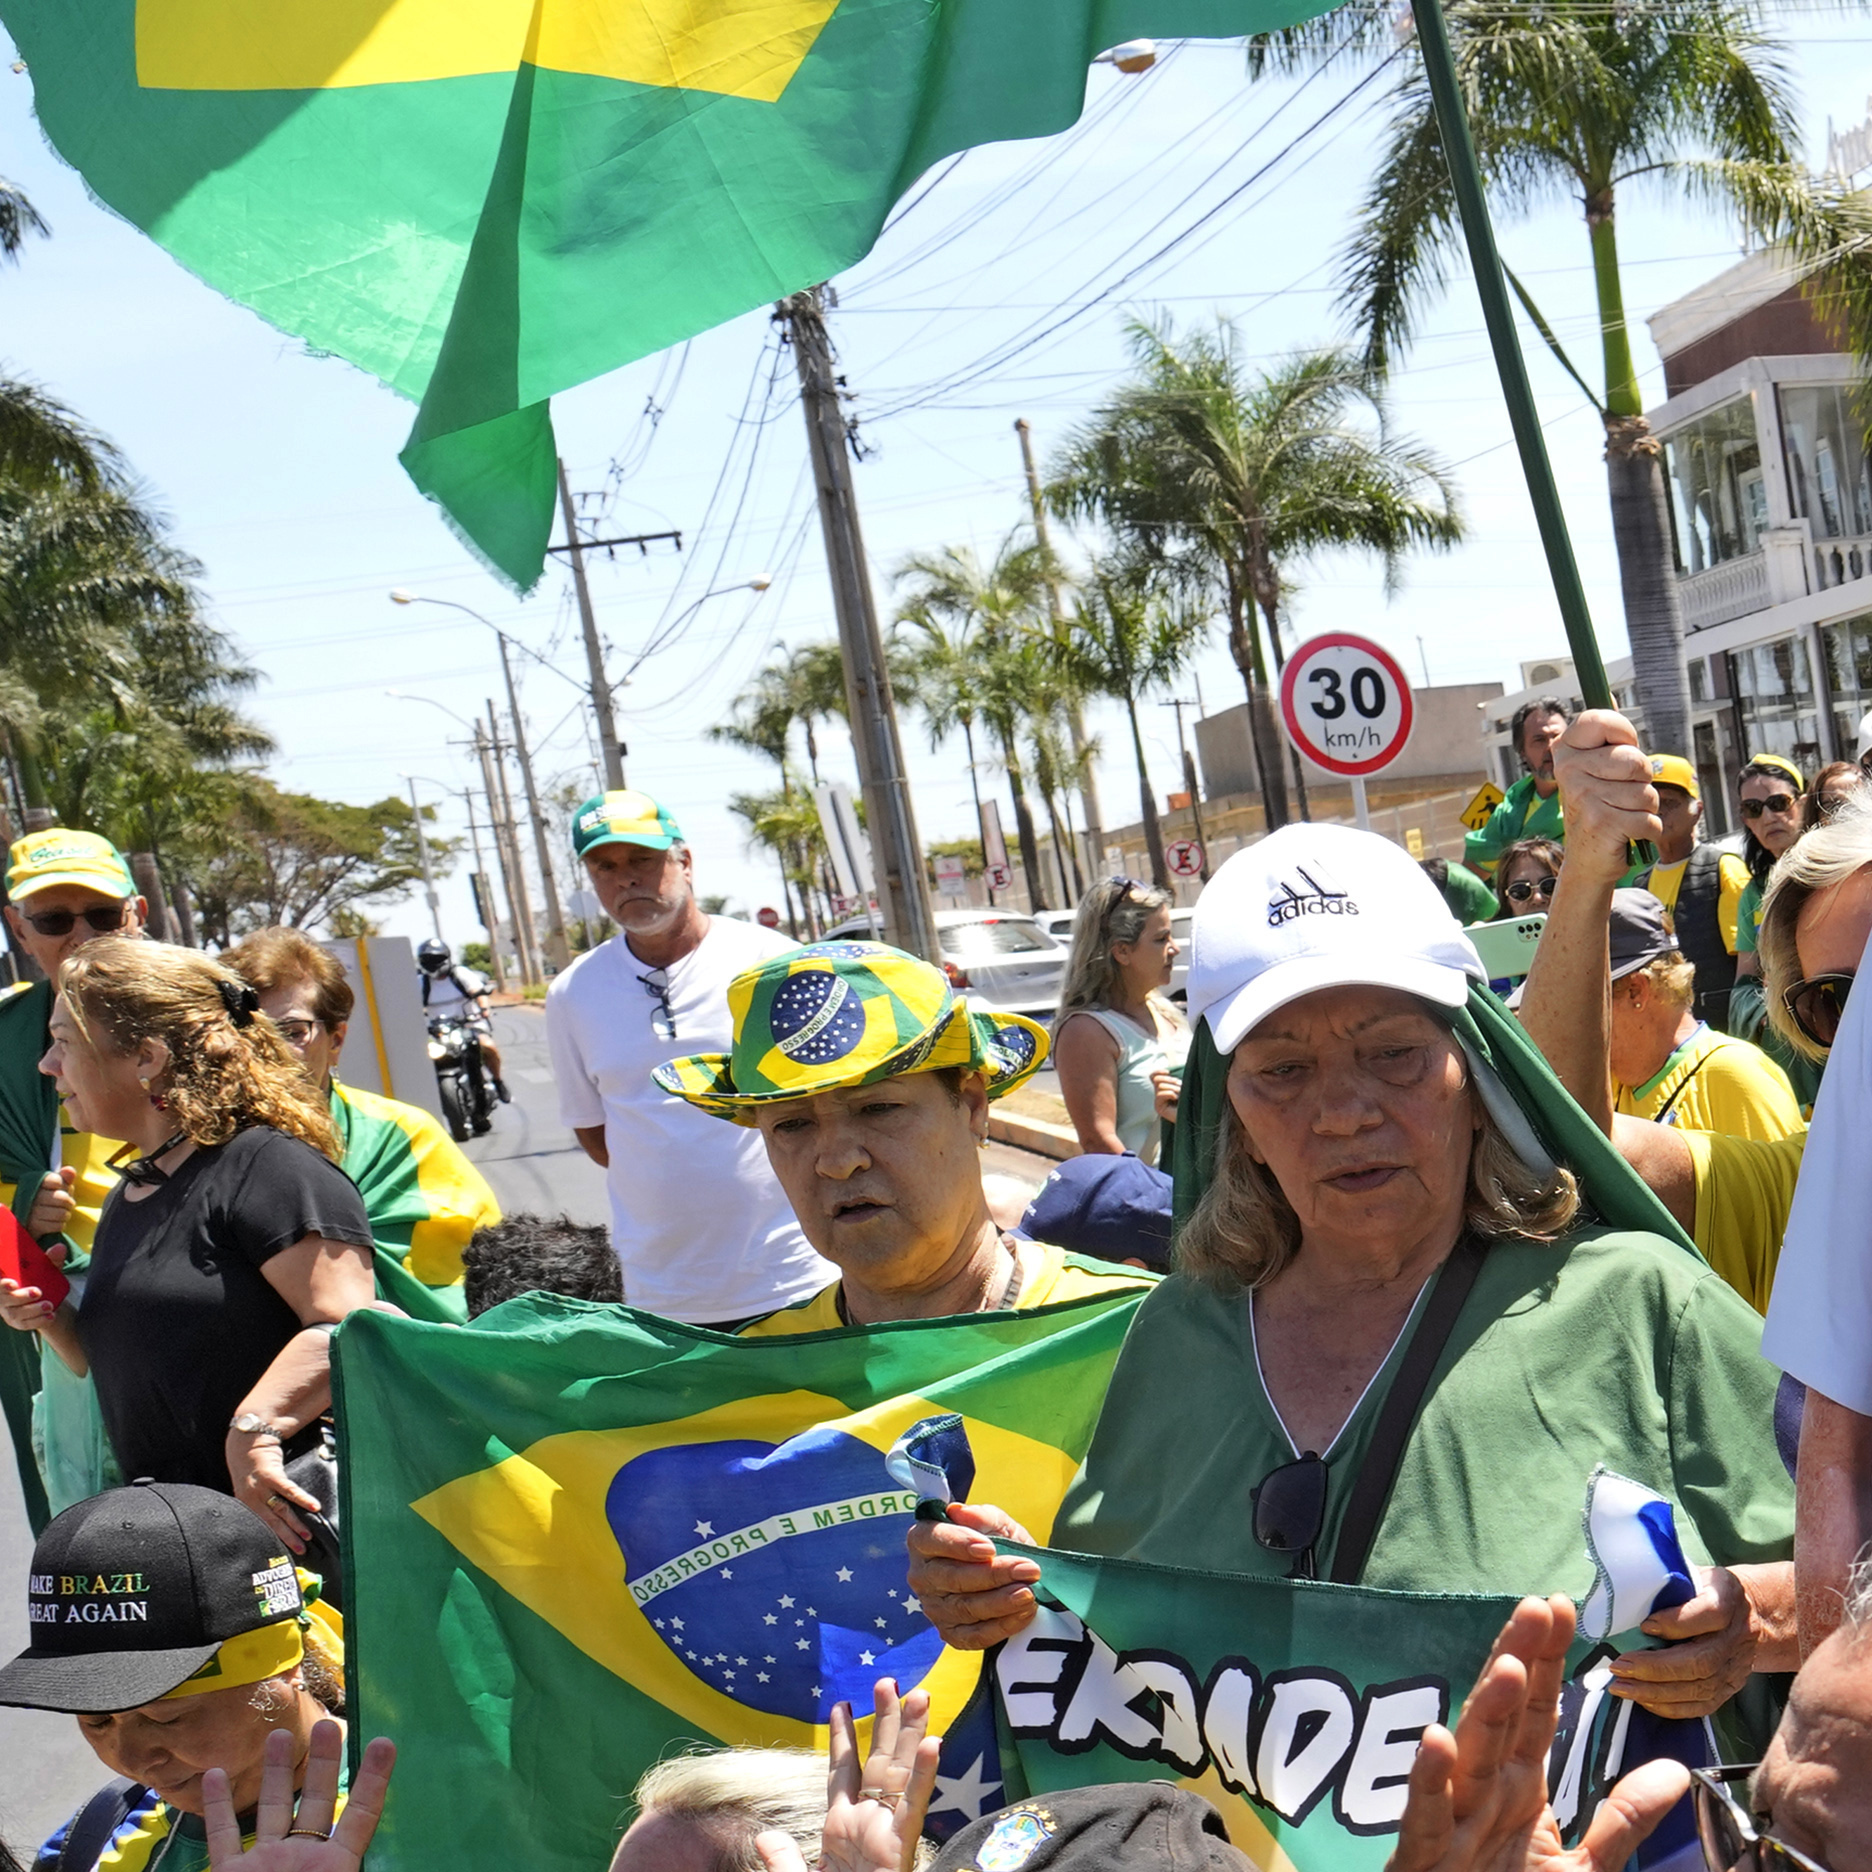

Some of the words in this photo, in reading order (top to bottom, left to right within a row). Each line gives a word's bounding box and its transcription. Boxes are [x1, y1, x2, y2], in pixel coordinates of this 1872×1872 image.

[1308, 667, 1387, 720] 30
[1324, 726, 1381, 748] km/h
[1267, 895, 1360, 927] adidas
[828, 980, 846, 1010] ORDEM
[823, 1007, 833, 1016] E
[781, 1014, 829, 1051] PROGRESSO
[60, 1573, 151, 1596] BRAZIL
[30, 1603, 60, 1623] REAT
[65, 1601, 148, 1624] AGAIN
